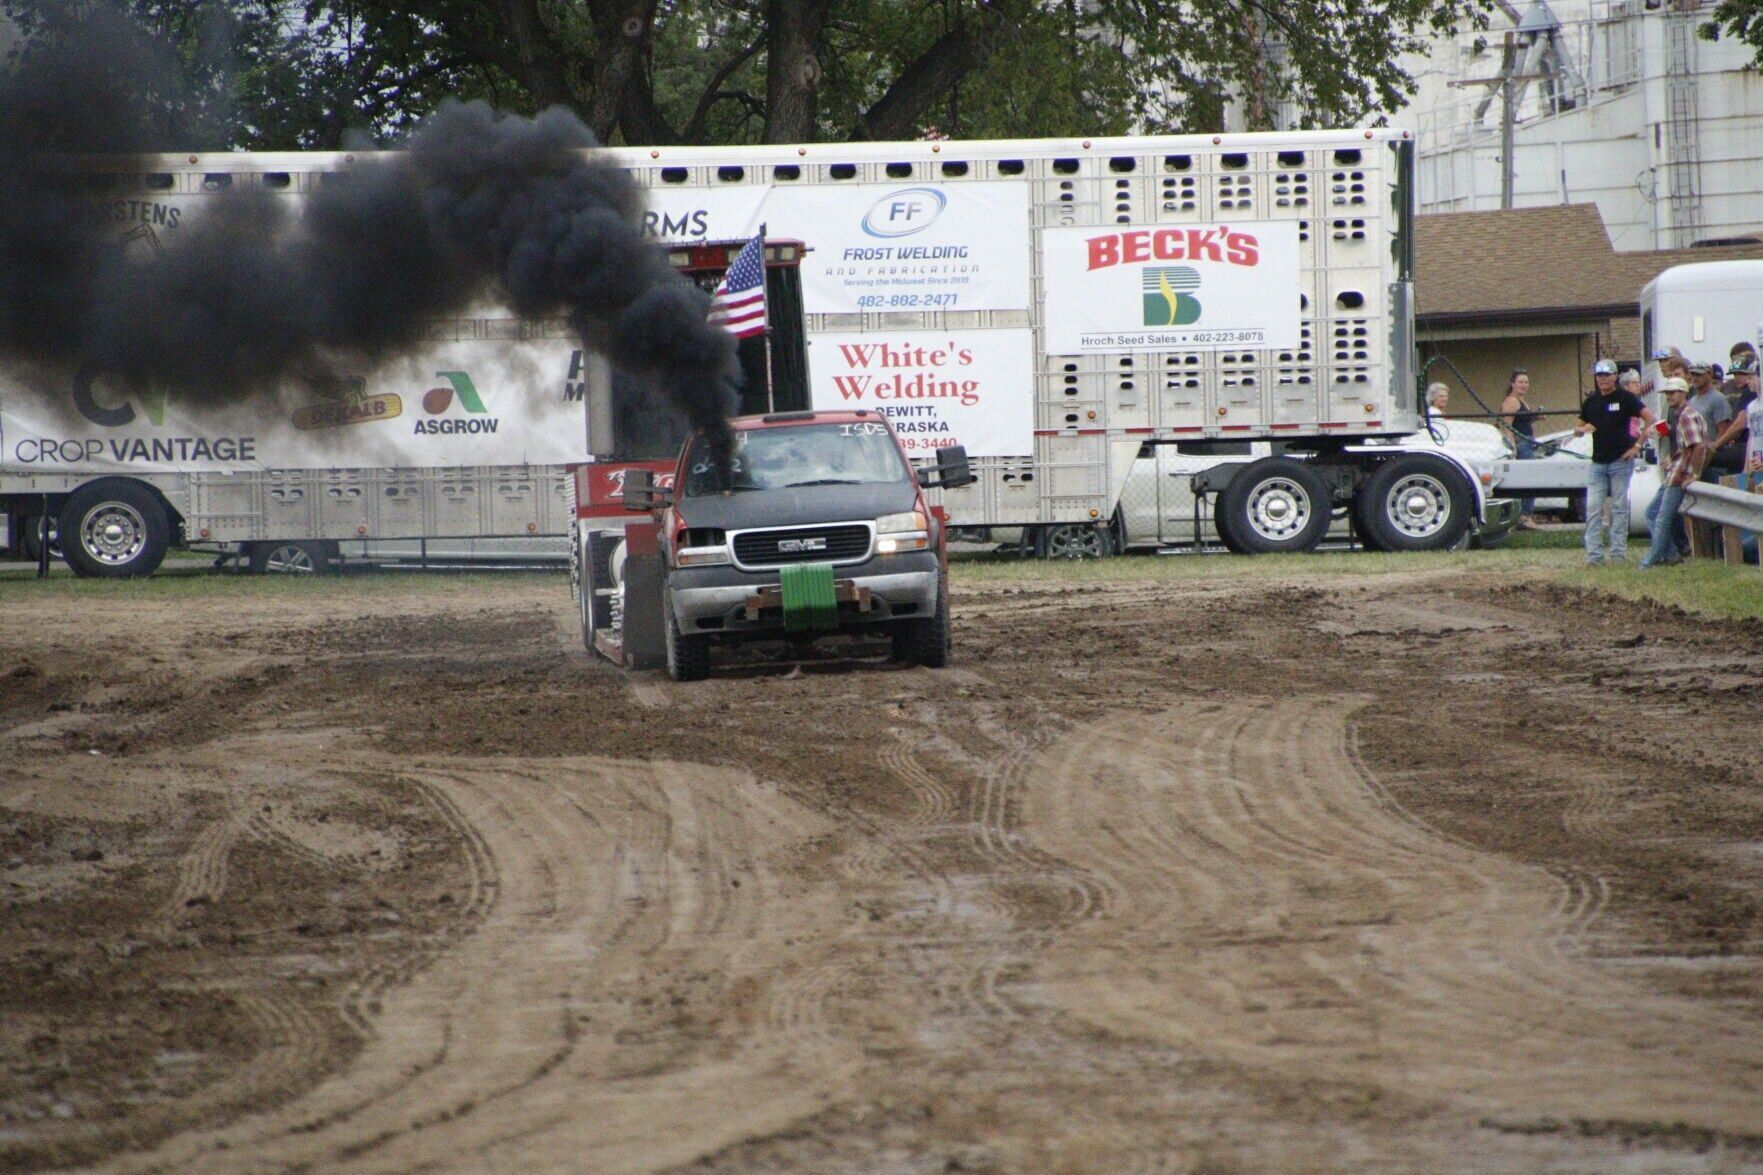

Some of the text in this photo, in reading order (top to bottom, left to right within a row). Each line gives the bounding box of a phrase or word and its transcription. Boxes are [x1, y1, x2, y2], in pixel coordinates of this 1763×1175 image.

[889, 202, 922, 221] FF
[843, 246, 968, 261] FROST WELDING
[1086, 226, 1259, 271] BECK'S
[825, 264, 980, 276] AND FABRICATION
[843, 279, 874, 287] Serving
[875, 278, 889, 286] the
[891, 277, 925, 285] Midwest
[857, 294, 958, 307] 402-802-2471
[1081, 331, 1264, 346] Hroch Seed Sales 402-223-8078
[838, 342, 973, 369] White's
[832, 373, 980, 406] Welding
[414, 419, 499, 435] ASGROW
[895, 421, 949, 433] RASKA
[16, 438, 256, 463] CROP VANTAGE
[778, 538, 827, 552] GMC
